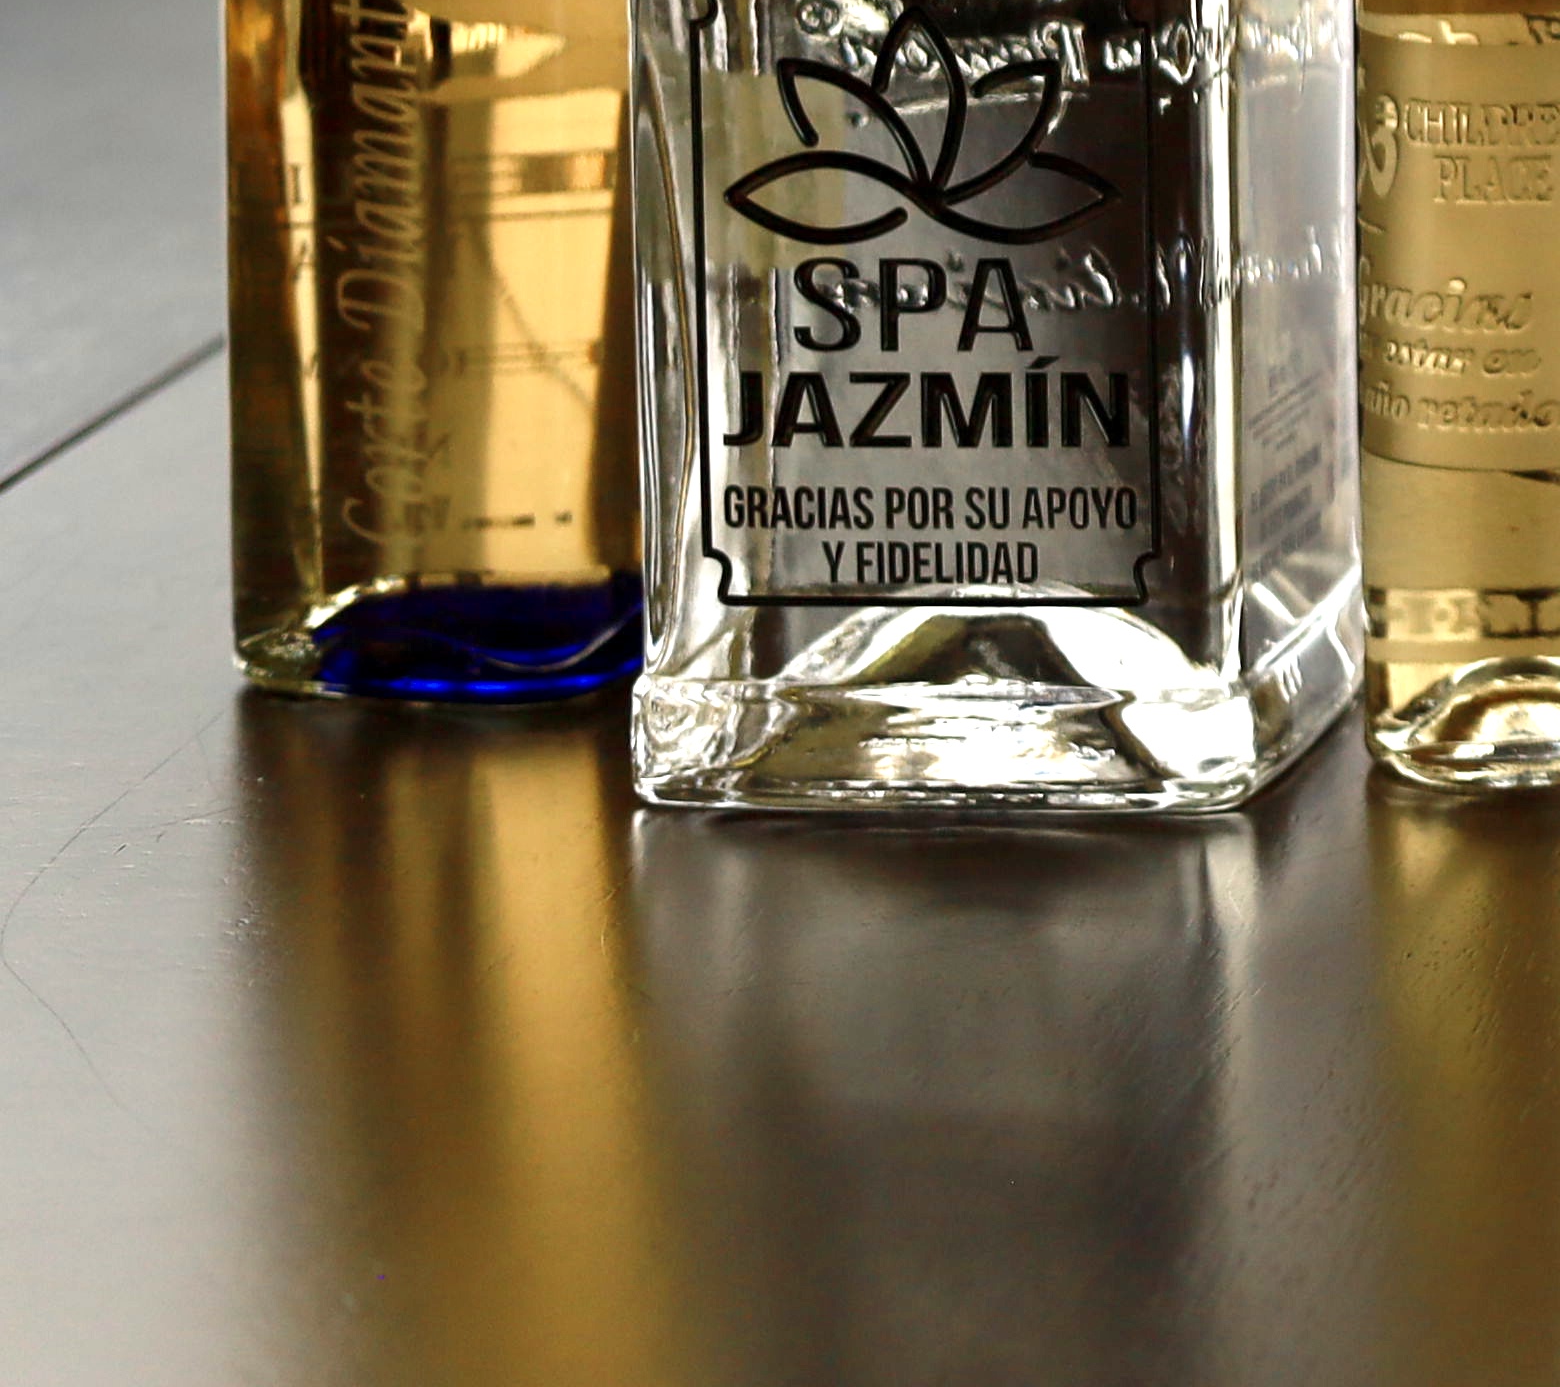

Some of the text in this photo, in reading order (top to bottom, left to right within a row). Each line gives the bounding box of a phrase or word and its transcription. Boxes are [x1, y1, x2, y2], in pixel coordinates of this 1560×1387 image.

[1432, 152, 1554, 206] PLACE
[790, 255, 1035, 354] SPA
[722, 355, 1131, 450] JAZMÍN
[723, 484, 1139, 531] GRACIAS POR SU APOYO
[822, 540, 1040, 585] Y FIDELIDAD
